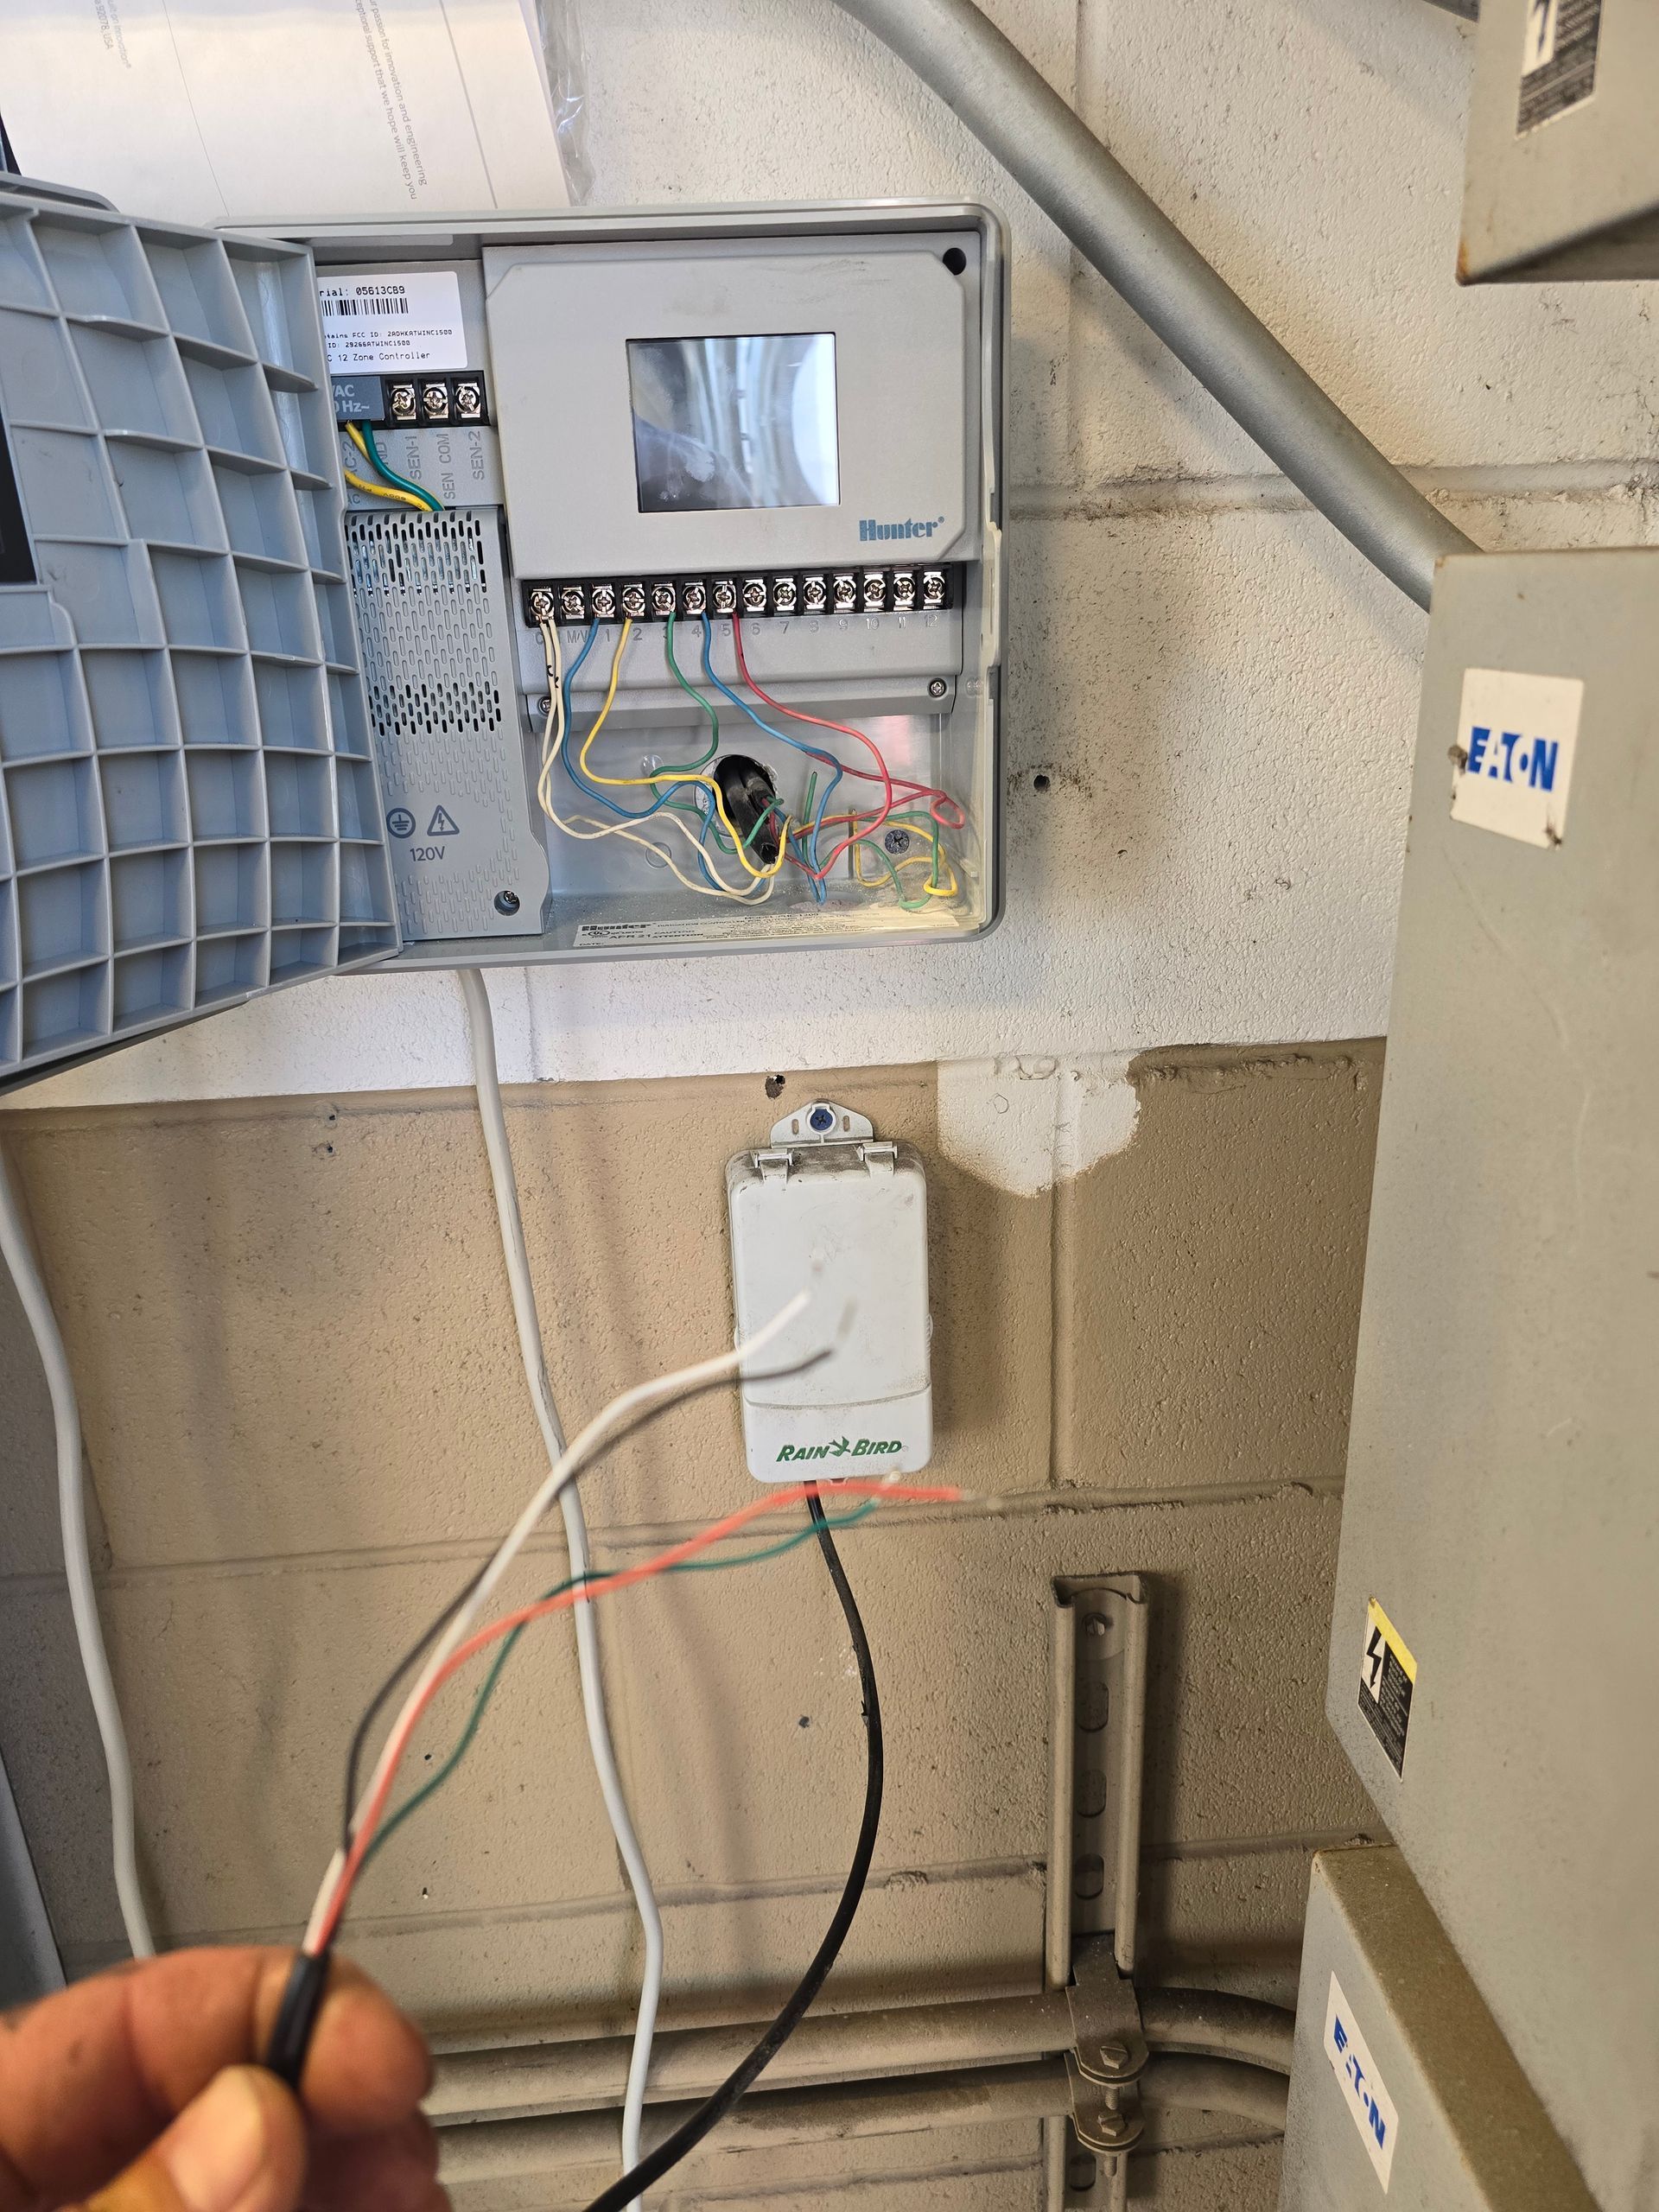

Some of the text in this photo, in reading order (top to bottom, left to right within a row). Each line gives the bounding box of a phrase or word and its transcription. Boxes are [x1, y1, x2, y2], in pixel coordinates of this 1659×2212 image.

[371, 8, 386, 38] passion
[104, 33, 113, 49] USA
[365, 35, 380, 68] support
[381, 38, 390, 50] for
[375, 68, 387, 90] that
[385, 51, 404, 101] innovation
[381, 90, 391, 106] we
[385, 106, 398, 134] hope
[398, 103, 411, 123] and
[393, 135, 405, 153] will
[404, 124, 428, 186] engineering
[399, 154, 411, 181] keep
[404, 181, 417, 200] you
[355, 285, 405, 296] 05613CB9
[378, 351, 430, 360] Controller
[404, 435, 422, 480] SEN-1
[435, 433, 456, 499] SEN COM
[468, 430, 486, 480] SEN-2
[605, 630, 610, 642] 1
[632, 628, 643, 641] 2
[691, 624, 702, 638] 4
[721, 623, 731, 637] 5
[751, 622, 760, 636] 6
[779, 620, 790, 634] 7
[809, 620, 819, 633] 8
[838, 619, 849, 632] 9
[866, 617, 880, 630] 10
[897, 616, 906, 629] 11
[924, 614, 938, 628] 12
[1467, 726, 1559, 792] EATON
[410, 845, 445, 861] 120V
[775, 1438, 903, 1462] RAIN BIRD
[1333, 2013, 1386, 2150] EATON
